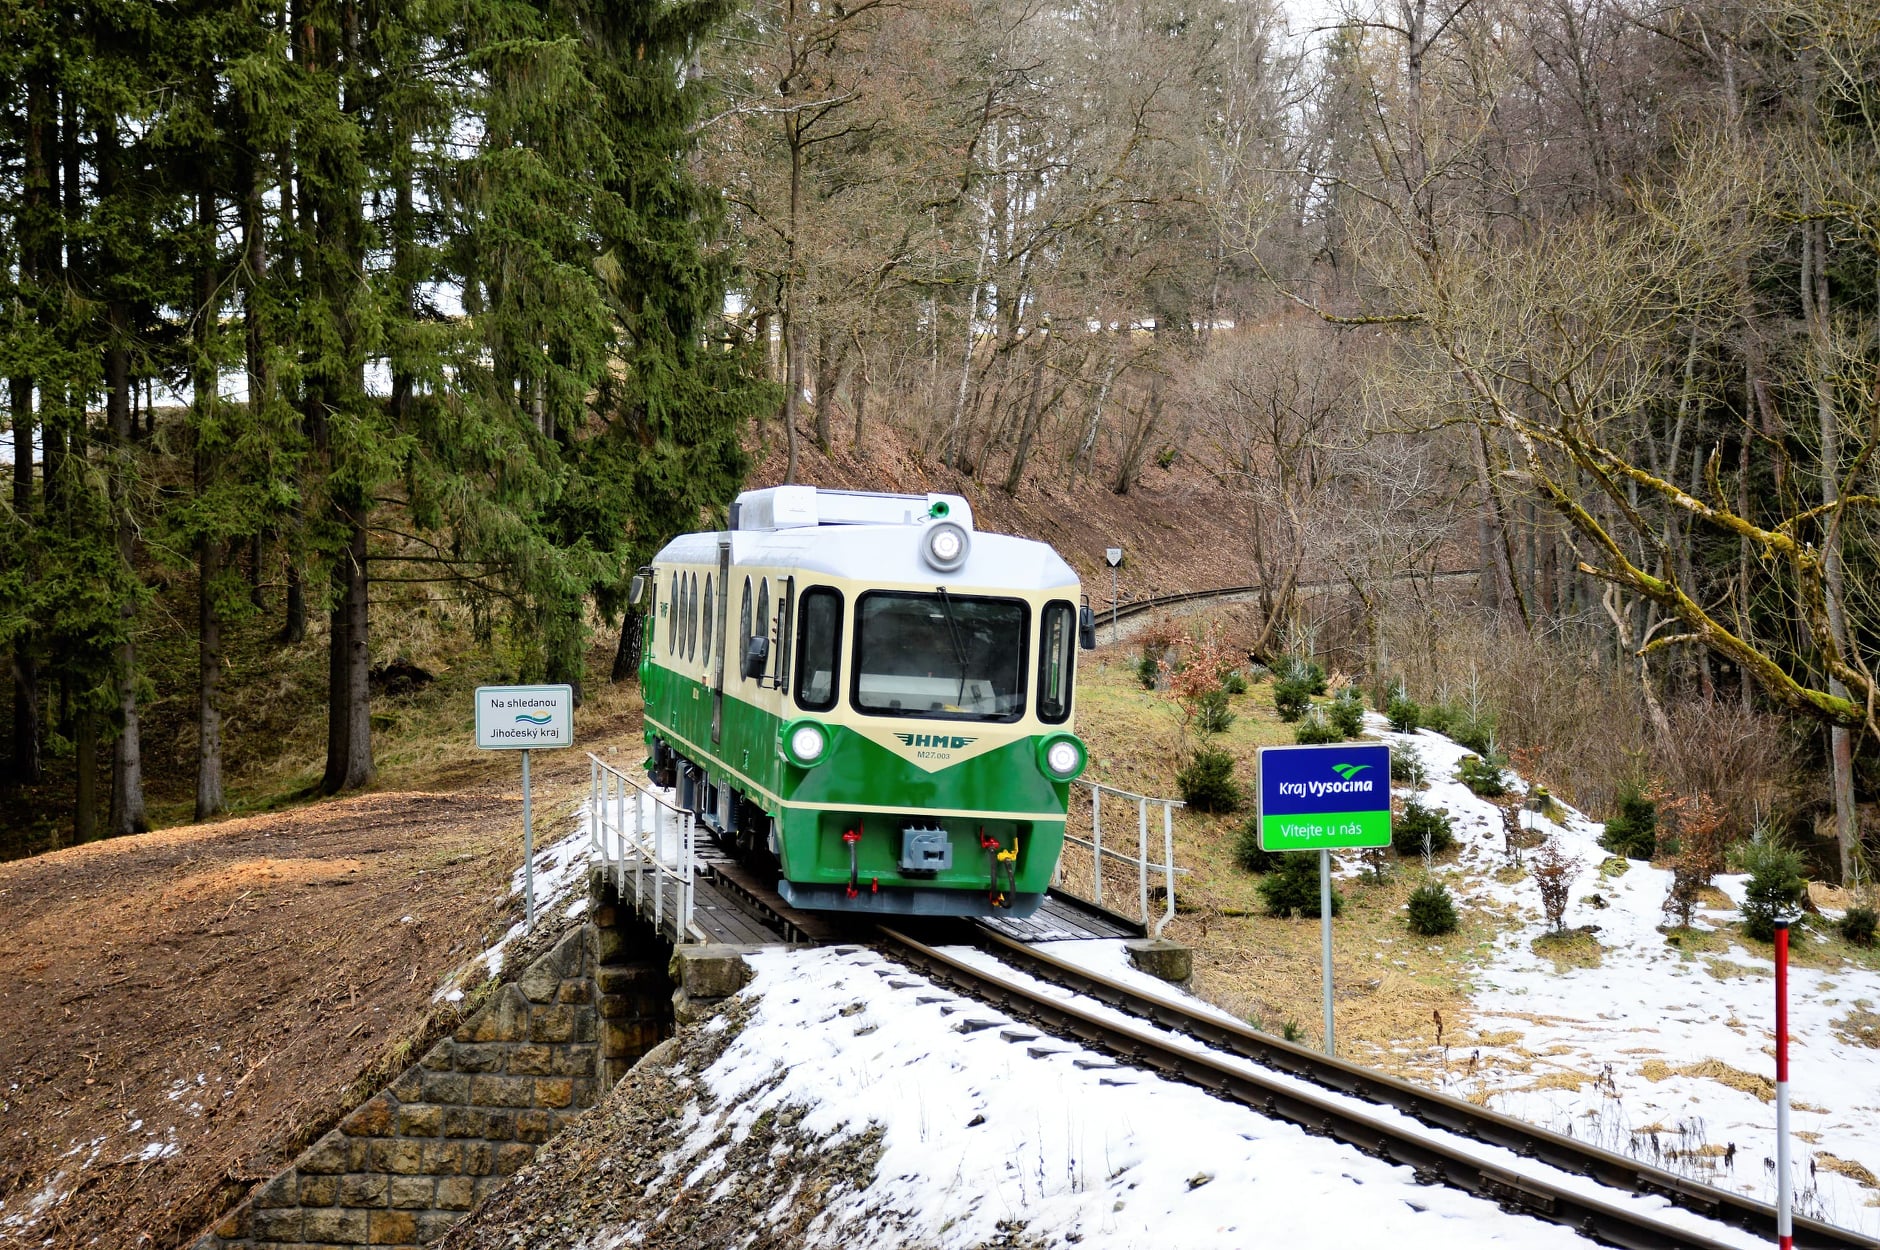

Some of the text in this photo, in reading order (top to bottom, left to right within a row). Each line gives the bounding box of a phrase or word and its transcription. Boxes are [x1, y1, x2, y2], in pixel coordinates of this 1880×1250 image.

[491, 698, 556, 708] Na shledanou
[490, 727, 559, 739] Jihočeský kraj
[897, 733, 972, 749] JHMD
[917, 751, 950, 760] M27.003
[1279, 782, 1306, 798] Kraj
[1281, 821, 1362, 840] Vítejte u nás
